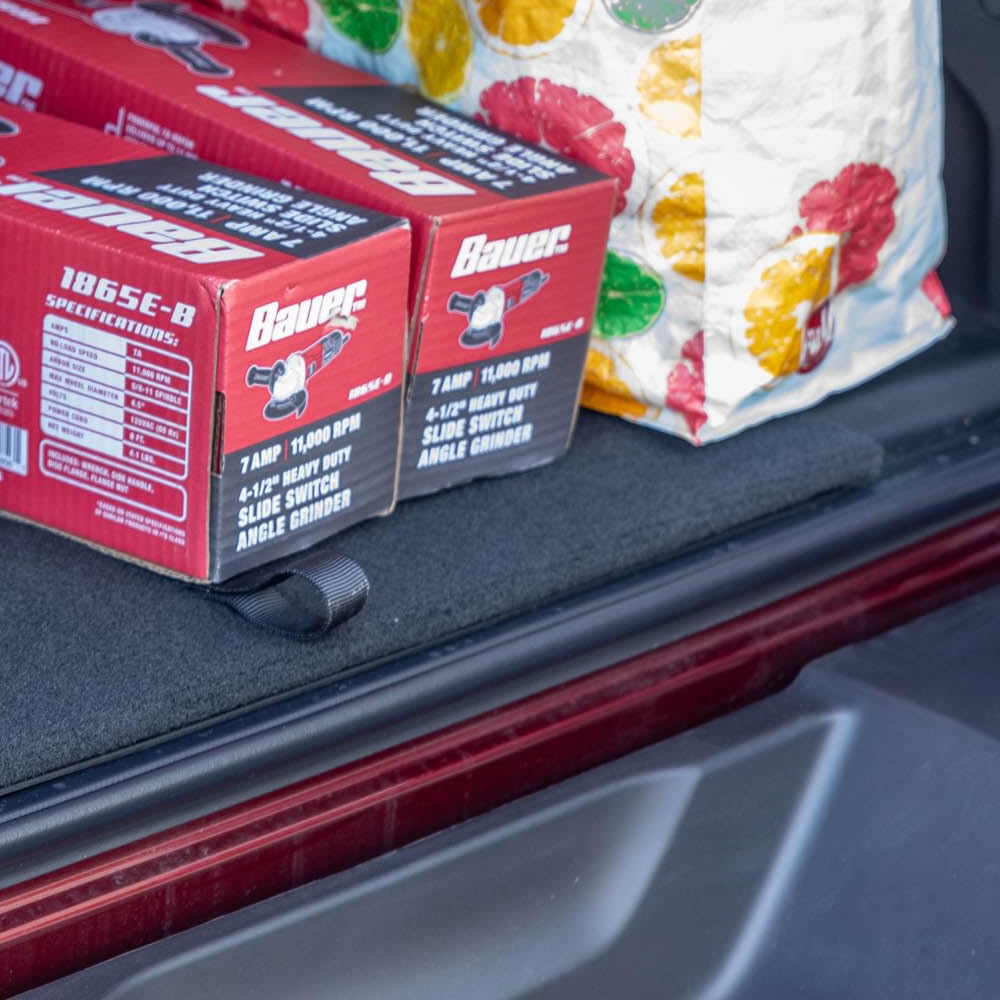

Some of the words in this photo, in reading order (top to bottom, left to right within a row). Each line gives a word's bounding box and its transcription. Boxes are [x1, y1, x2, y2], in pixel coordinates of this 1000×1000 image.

[196, 85, 477, 196] Bauer
[80, 174, 142, 196] RPM
[137, 191, 215, 219] 11,000
[155, 183, 207, 201] DUTY
[196, 184, 283, 213] SWITCH
[197, 171, 294, 204] GRINDER
[203, 198, 266, 220] HEAVY
[279, 209, 347, 233] SLIDE
[290, 200, 369, 226] ANGLE
[224, 221, 288, 242] AMP
[280, 238, 304, 248] 7
[450, 224, 572, 278] Bauer
[60, 266, 197, 328] 1865E-B
[245, 279, 368, 351] Bauer
[45, 293, 179, 347] SPECIFICATIONS:
[156, 372, 171, 385] RPM
[431, 378, 442, 396] 7
[440, 370, 472, 394] AMP
[481, 359, 521, 384] 11,000
[521, 351, 551, 375] RPM
[426, 399, 467, 422] 4-1/2"
[468, 389, 507, 413] HEAVY
[508, 382, 538, 404] DUTY
[240, 455, 250, 474] 7
[250, 444, 282, 470] AMP
[290, 425, 331, 455] 11,000
[333, 412, 361, 438] RPM
[421, 418, 467, 446] SLIDE
[468, 404, 525, 435] SWITCH
[417, 439, 468, 470] ANGLE
[470, 423, 533, 456] GRINDER
[239, 474, 280, 503] 4-1/2"
[282, 459, 320, 487] HEAVY
[322, 445, 352, 471] DUTY
[238, 494, 281, 527] SLIDE
[285, 470, 340, 509] SWITCH
[236, 515, 286, 552] ANGLE
[289, 489, 351, 531] GRINDER
